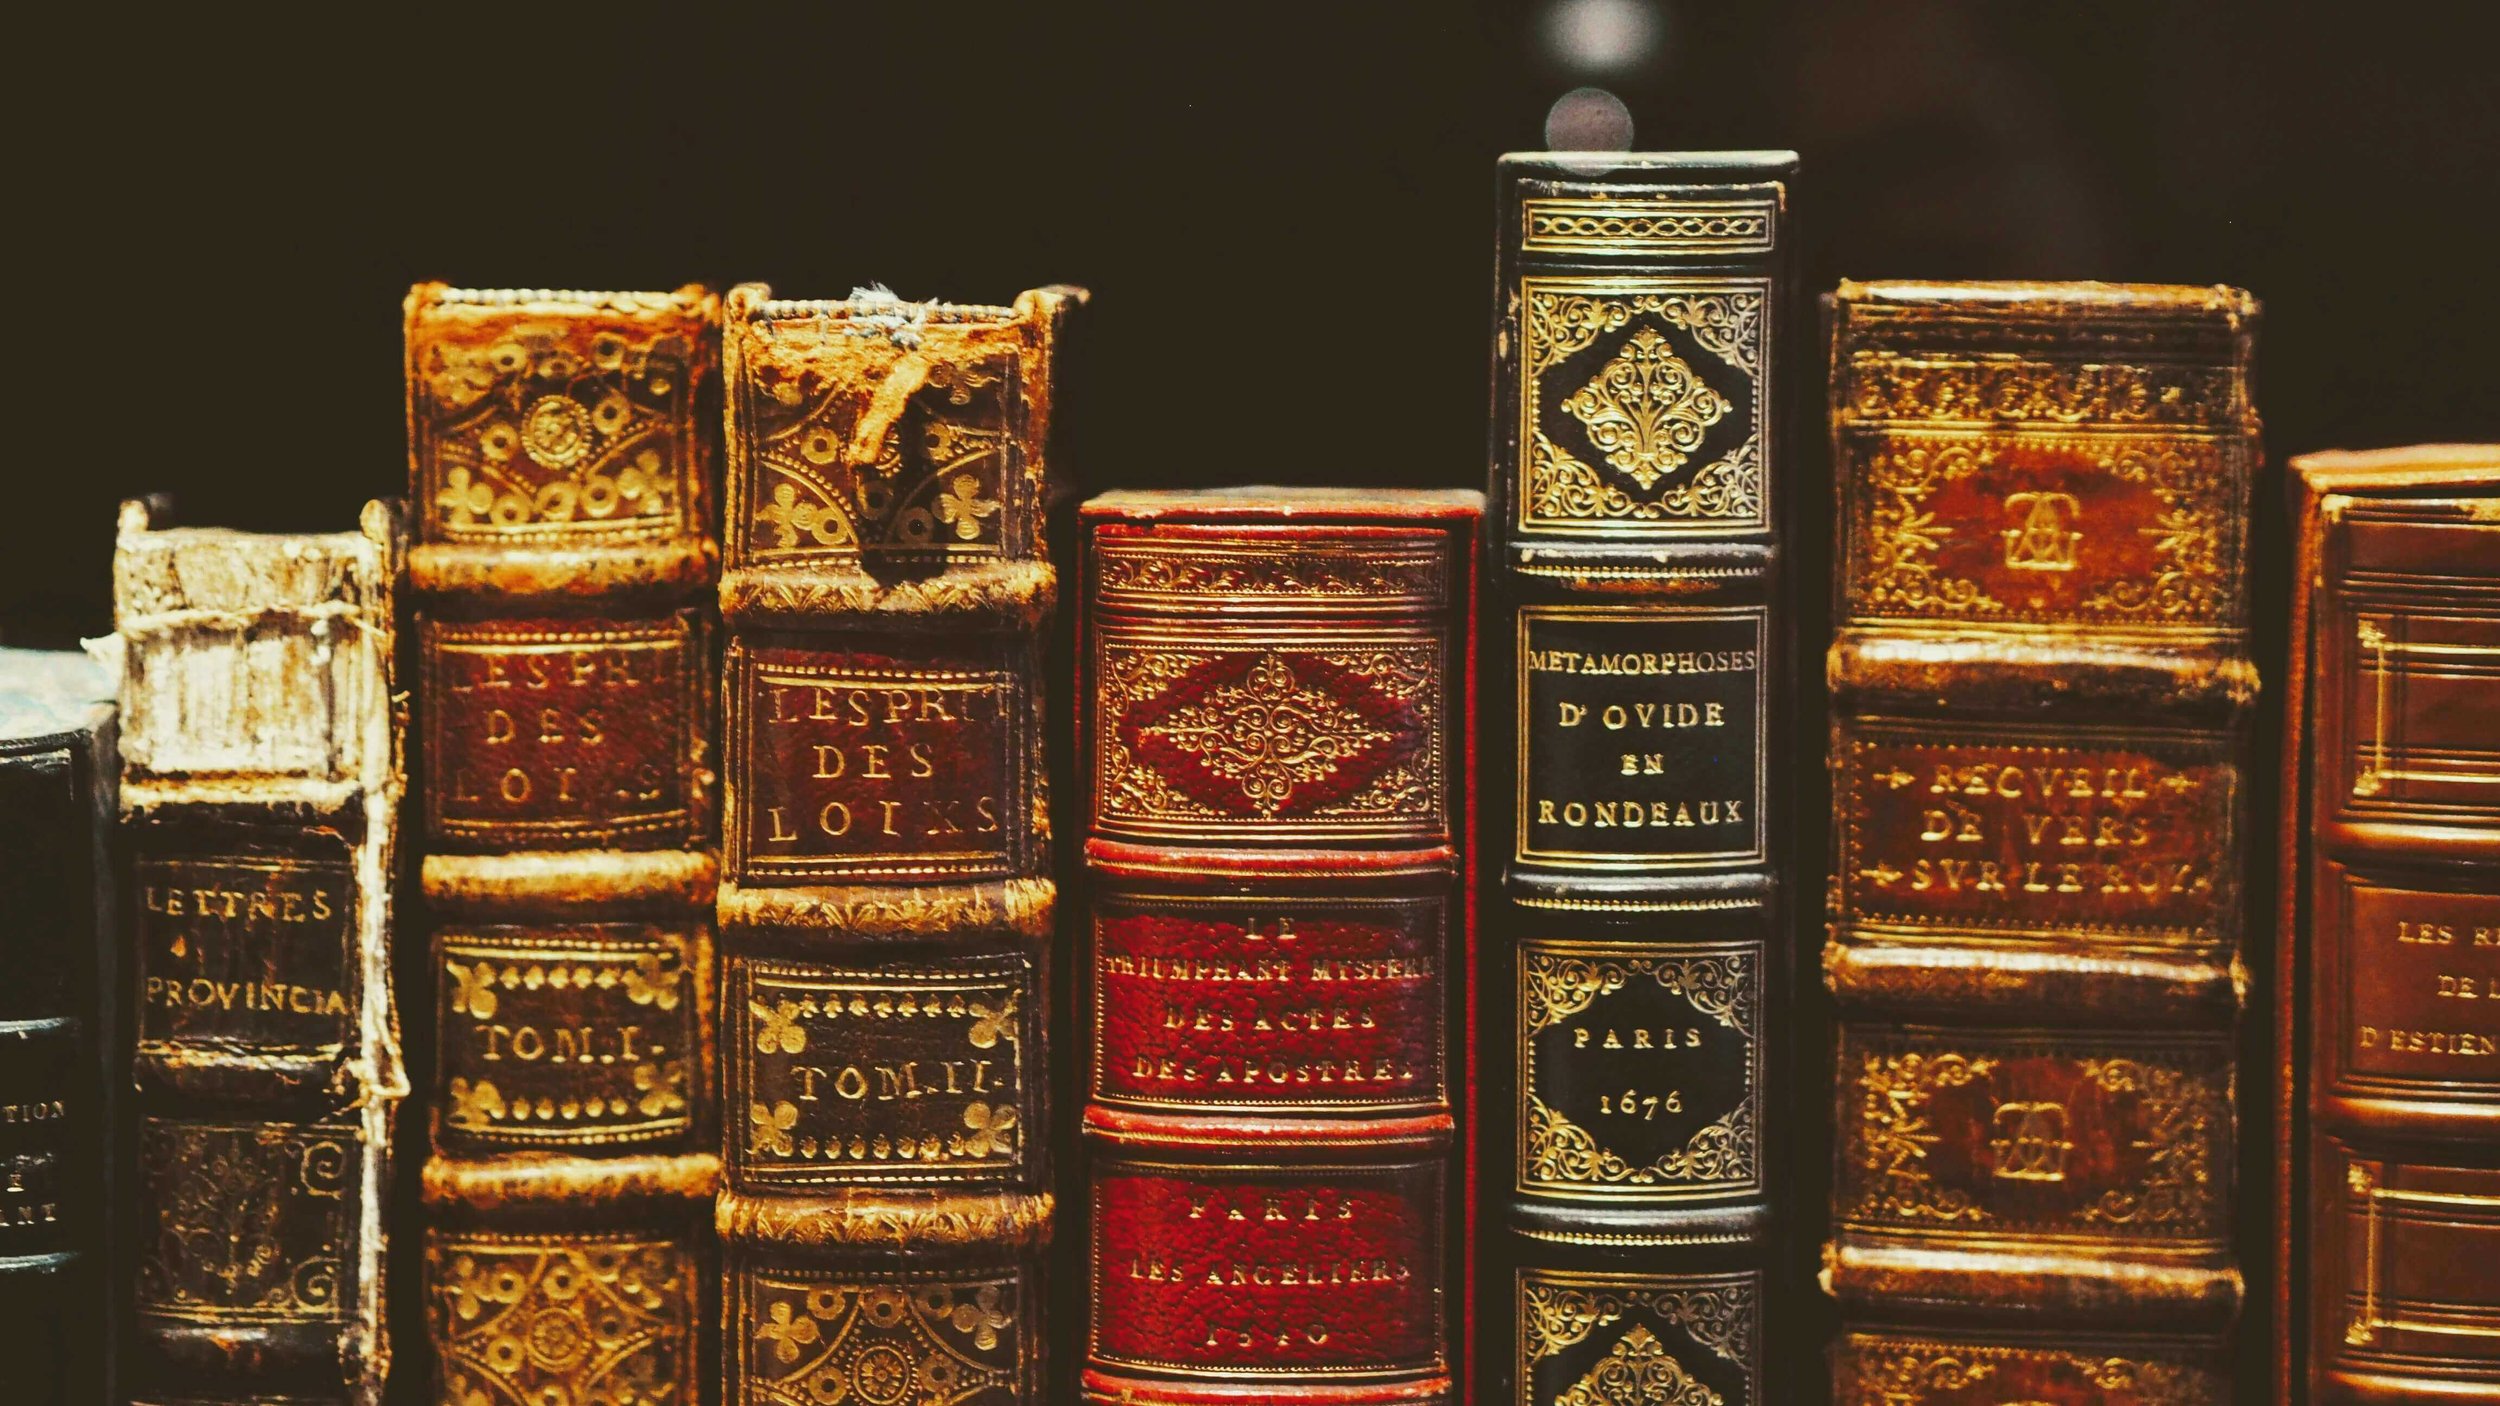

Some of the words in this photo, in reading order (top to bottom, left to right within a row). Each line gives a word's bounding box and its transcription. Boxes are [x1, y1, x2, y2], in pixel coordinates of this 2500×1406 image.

[1529, 650, 1758, 676] METAMORPHOSES
[485, 707, 605, 746] DES
[811, 743, 935, 779] DES
[1620, 753, 1665, 777] EN
[1930, 764, 2148, 799] RECVEIL
[1537, 799, 1744, 829] RONDEAUX
[1920, 808, 1984, 842] DE
[2023, 814, 2149, 846] VERS
[146, 887, 333, 922] LETTRES
[1244, 917, 1298, 940] LE
[2397, 920, 2454, 944] LES
[2473, 926, 2500, 947] R
[146, 976, 349, 1016] PROVINCIA
[2437, 974, 2479, 999] DE
[1574, 1027, 1702, 1050] PARIS
[1600, 1088, 1683, 1121] 1676
